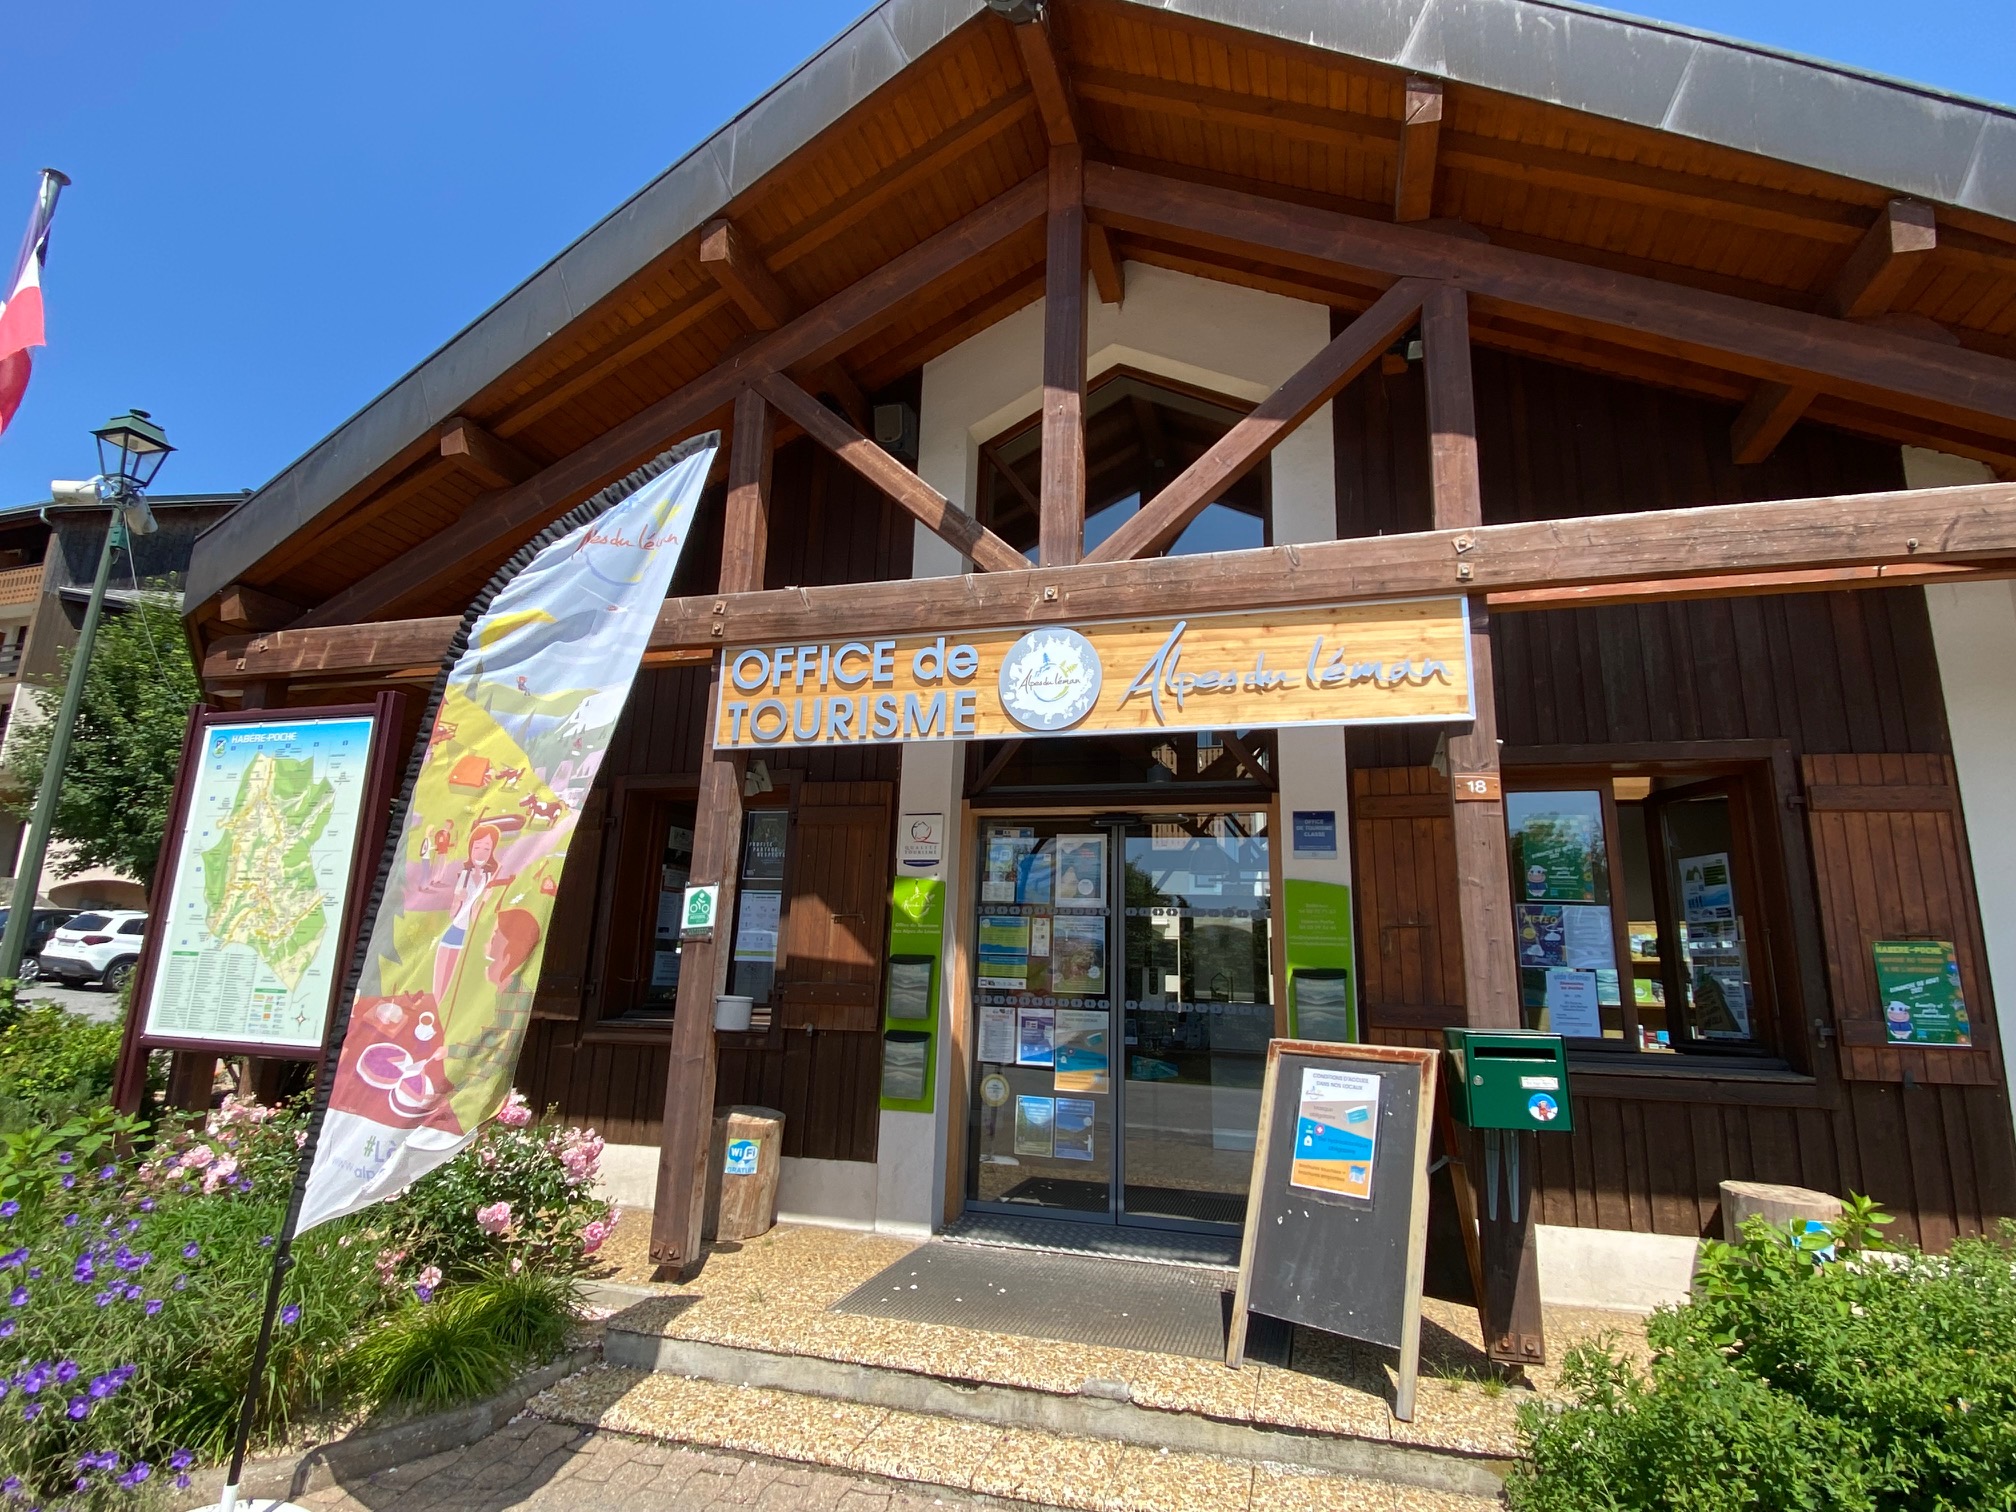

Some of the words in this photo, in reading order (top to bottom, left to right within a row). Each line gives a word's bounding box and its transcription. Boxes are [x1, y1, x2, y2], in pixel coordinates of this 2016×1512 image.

[732, 640, 896, 690] OFFICE
[912, 637, 979, 680] de
[1117, 620, 1240, 721] Alpes
[1306, 634, 1454, 683] léman
[728, 689, 977, 742] TOURISME
[1466, 779, 1488, 794] 18
